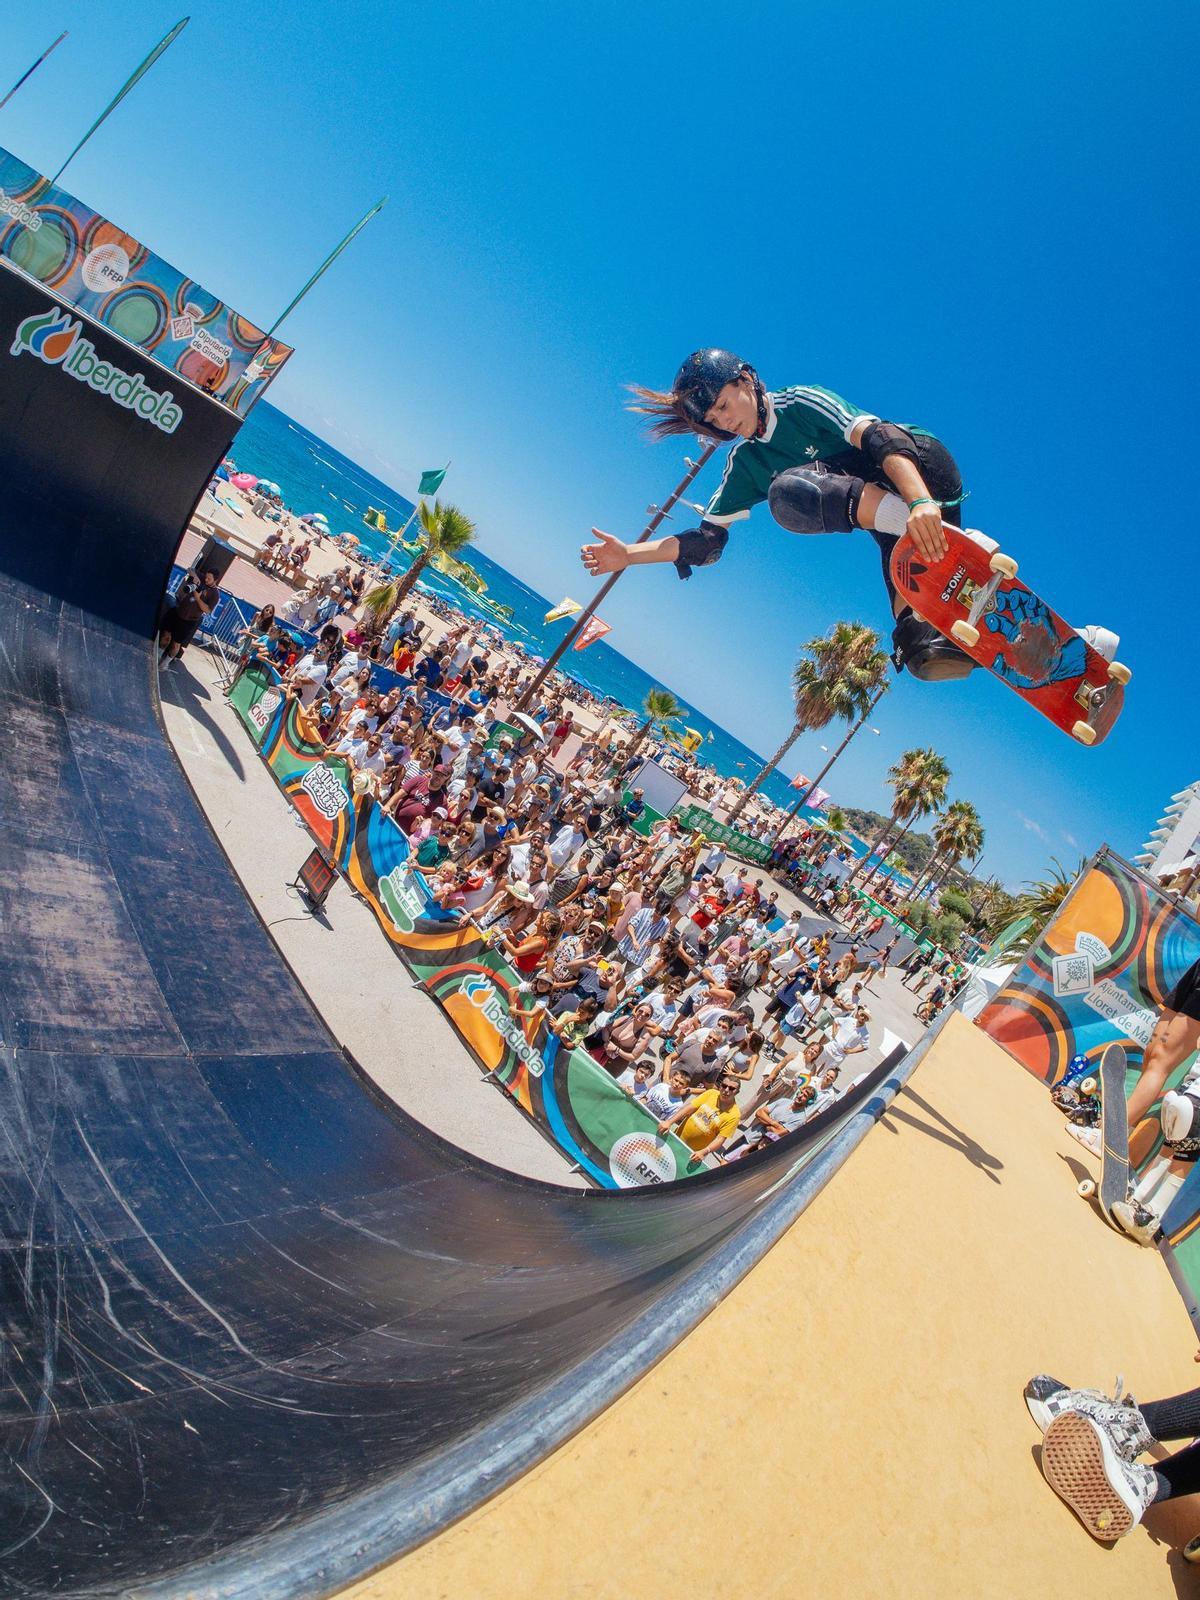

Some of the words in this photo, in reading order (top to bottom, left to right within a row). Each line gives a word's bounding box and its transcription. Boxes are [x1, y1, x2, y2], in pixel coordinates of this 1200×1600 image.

[101, 265, 124, 284] RFEP
[192, 340, 201, 350] de
[203, 346, 224, 364] Girona
[198, 330, 230, 356] Diputació
[67, 343, 180, 430] Iberdrola
[252, 704, 268, 727] CNS
[1088, 992, 1118, 1019] Lloret
[1118, 1013, 1132, 1030] de
[1100, 982, 1151, 1022] Ajuntament
[484, 1002, 544, 1074] Iberdrola
[636, 1161, 664, 1185] RFE
